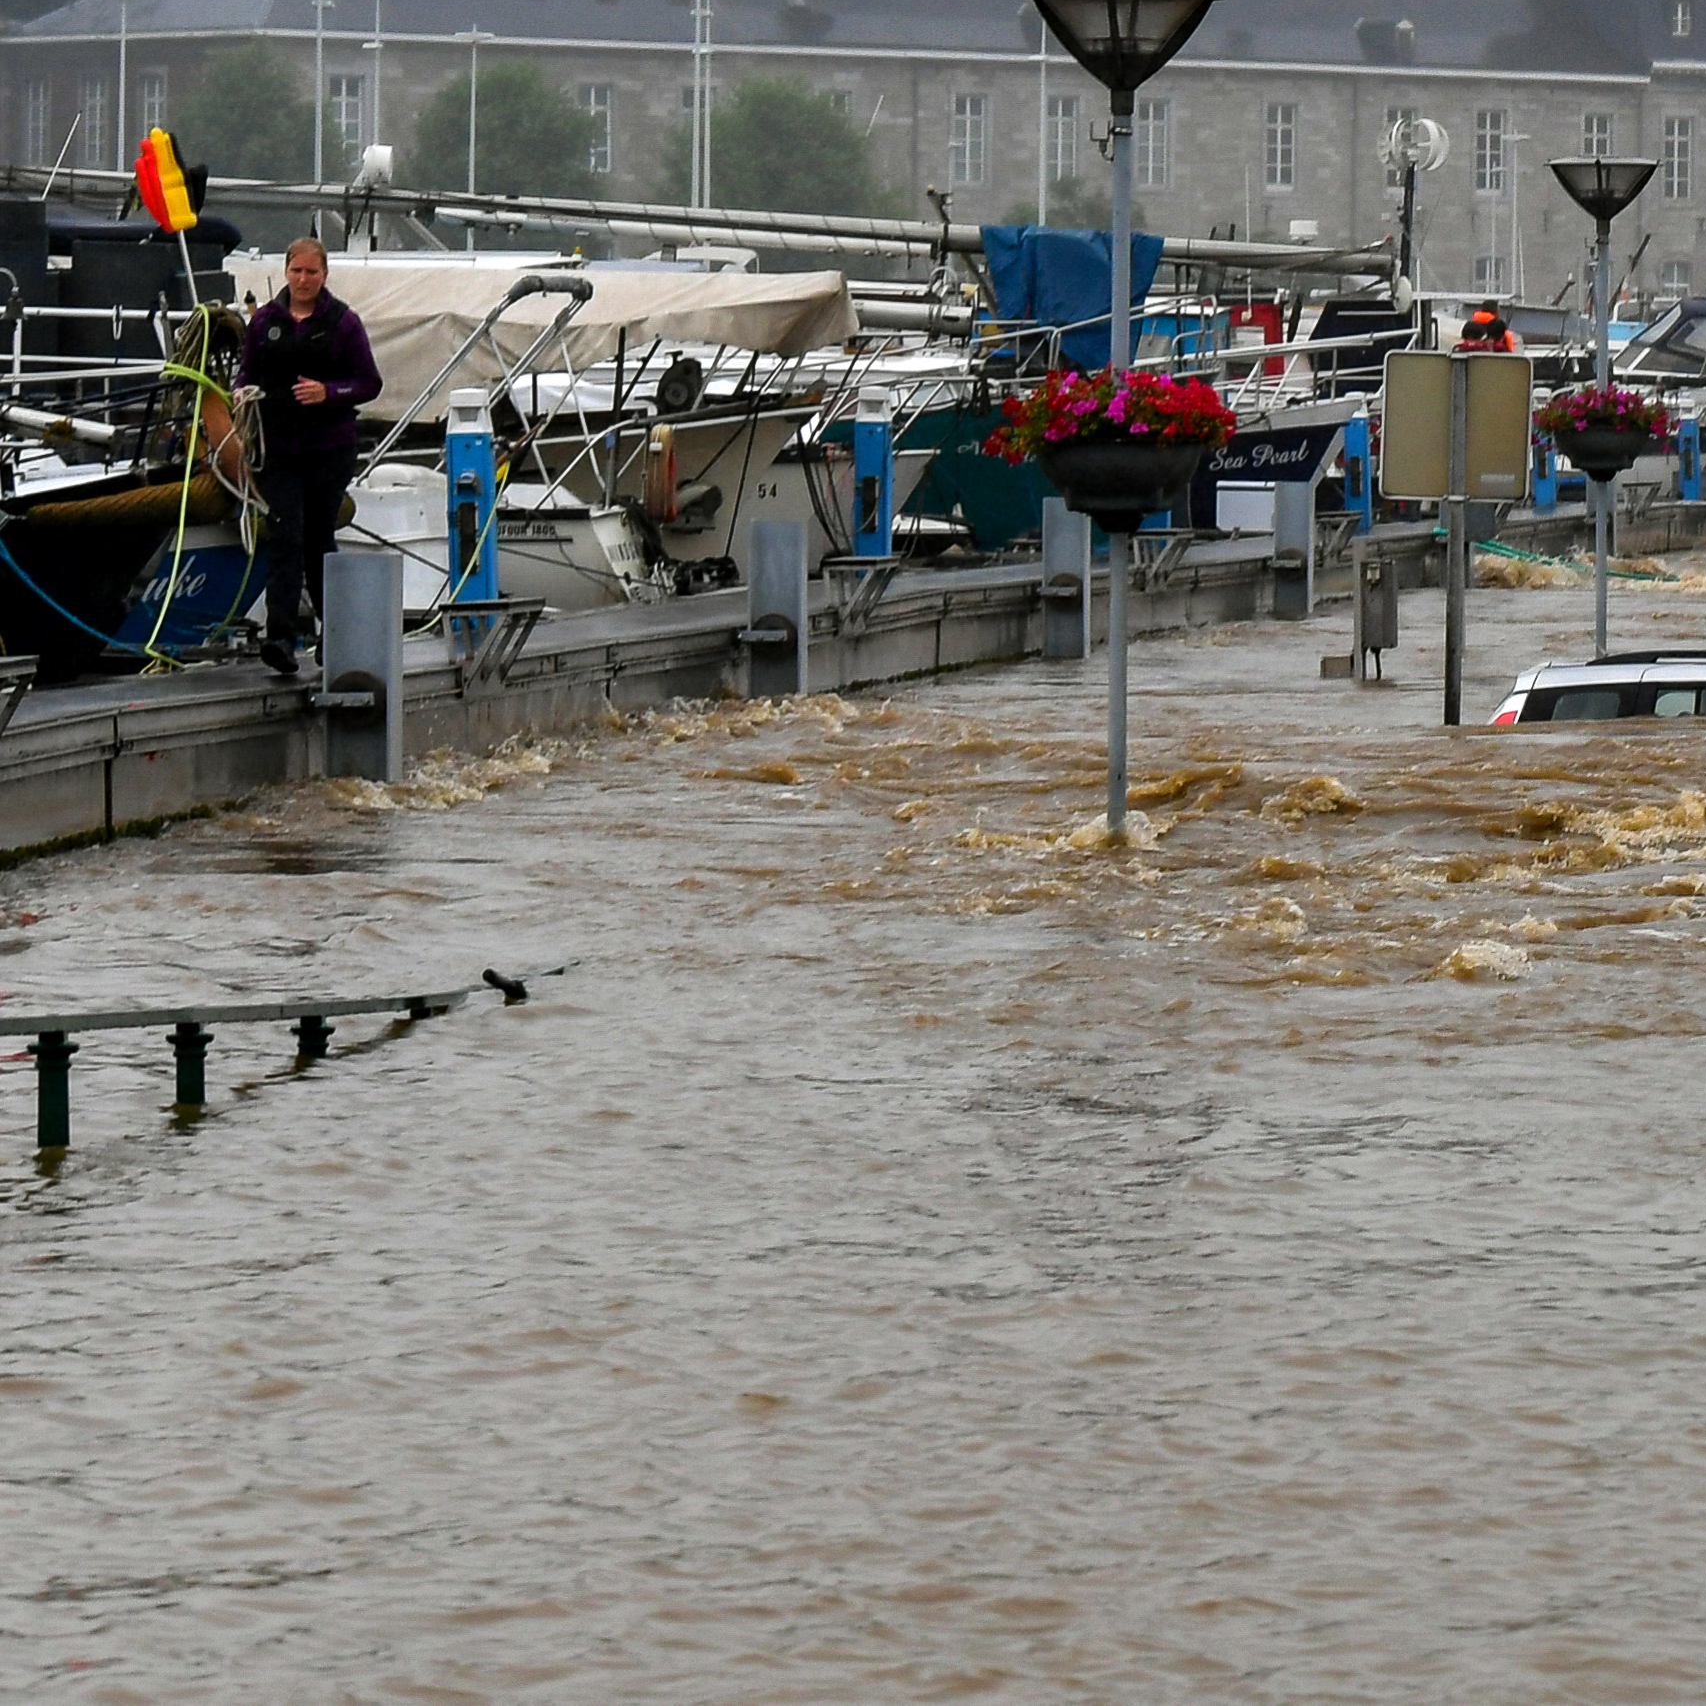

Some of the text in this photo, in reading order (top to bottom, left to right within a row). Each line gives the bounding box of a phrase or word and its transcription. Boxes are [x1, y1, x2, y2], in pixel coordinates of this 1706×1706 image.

[1209, 439, 1309, 471] Sea Pearl
[757, 483, 777, 499] 54
[142, 554, 208, 602] uke
